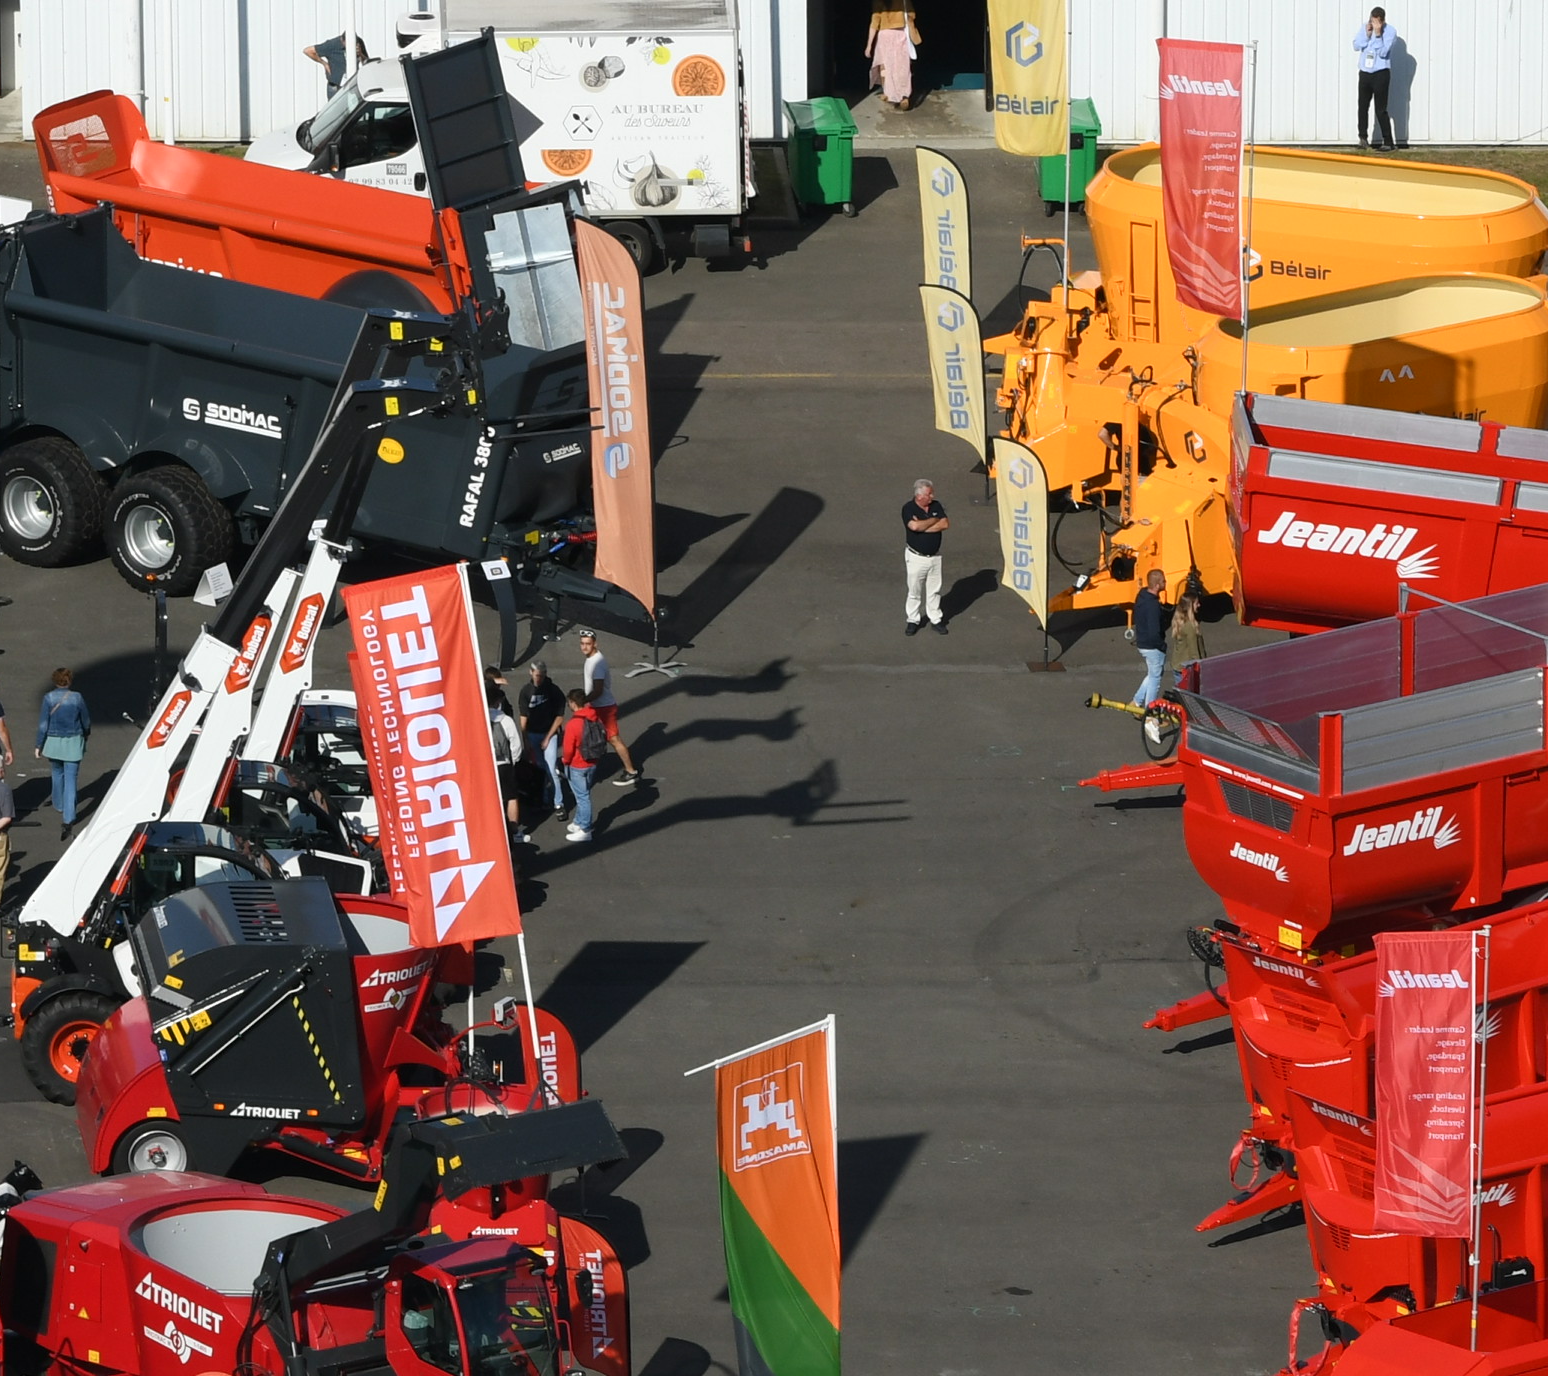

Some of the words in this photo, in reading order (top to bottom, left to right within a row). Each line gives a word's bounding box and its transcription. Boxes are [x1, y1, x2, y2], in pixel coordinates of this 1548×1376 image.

[612, 103, 635, 114] AU
[638, 103, 704, 114] BUREAU
[995, 92, 1059, 115] Bélair
[644, 115, 692, 128] Saveurs
[1270, 259, 1332, 281] Bélair
[204, 403, 282, 432] SODIMAC
[459, 469, 485, 528] RAFAL
[1257, 512, 1417, 563] Jeantil
[296, 602, 320, 638] Bobcat
[243, 624, 266, 660] Bobcat
[164, 697, 187, 728] Bobcat
[1344, 806, 1442, 855] Jeantil
[1231, 841, 1279, 871] Jeantil
[378, 961, 432, 985] TRIOLIET
[1252, 957, 1305, 979] Jeantil
[244, 1108, 301, 1120] TRIOLIET
[1312, 1102, 1360, 1128] Jeantil
[482, 1228, 518, 1236] TRIOLIET
[150, 1285, 223, 1334] TRIOLIET
